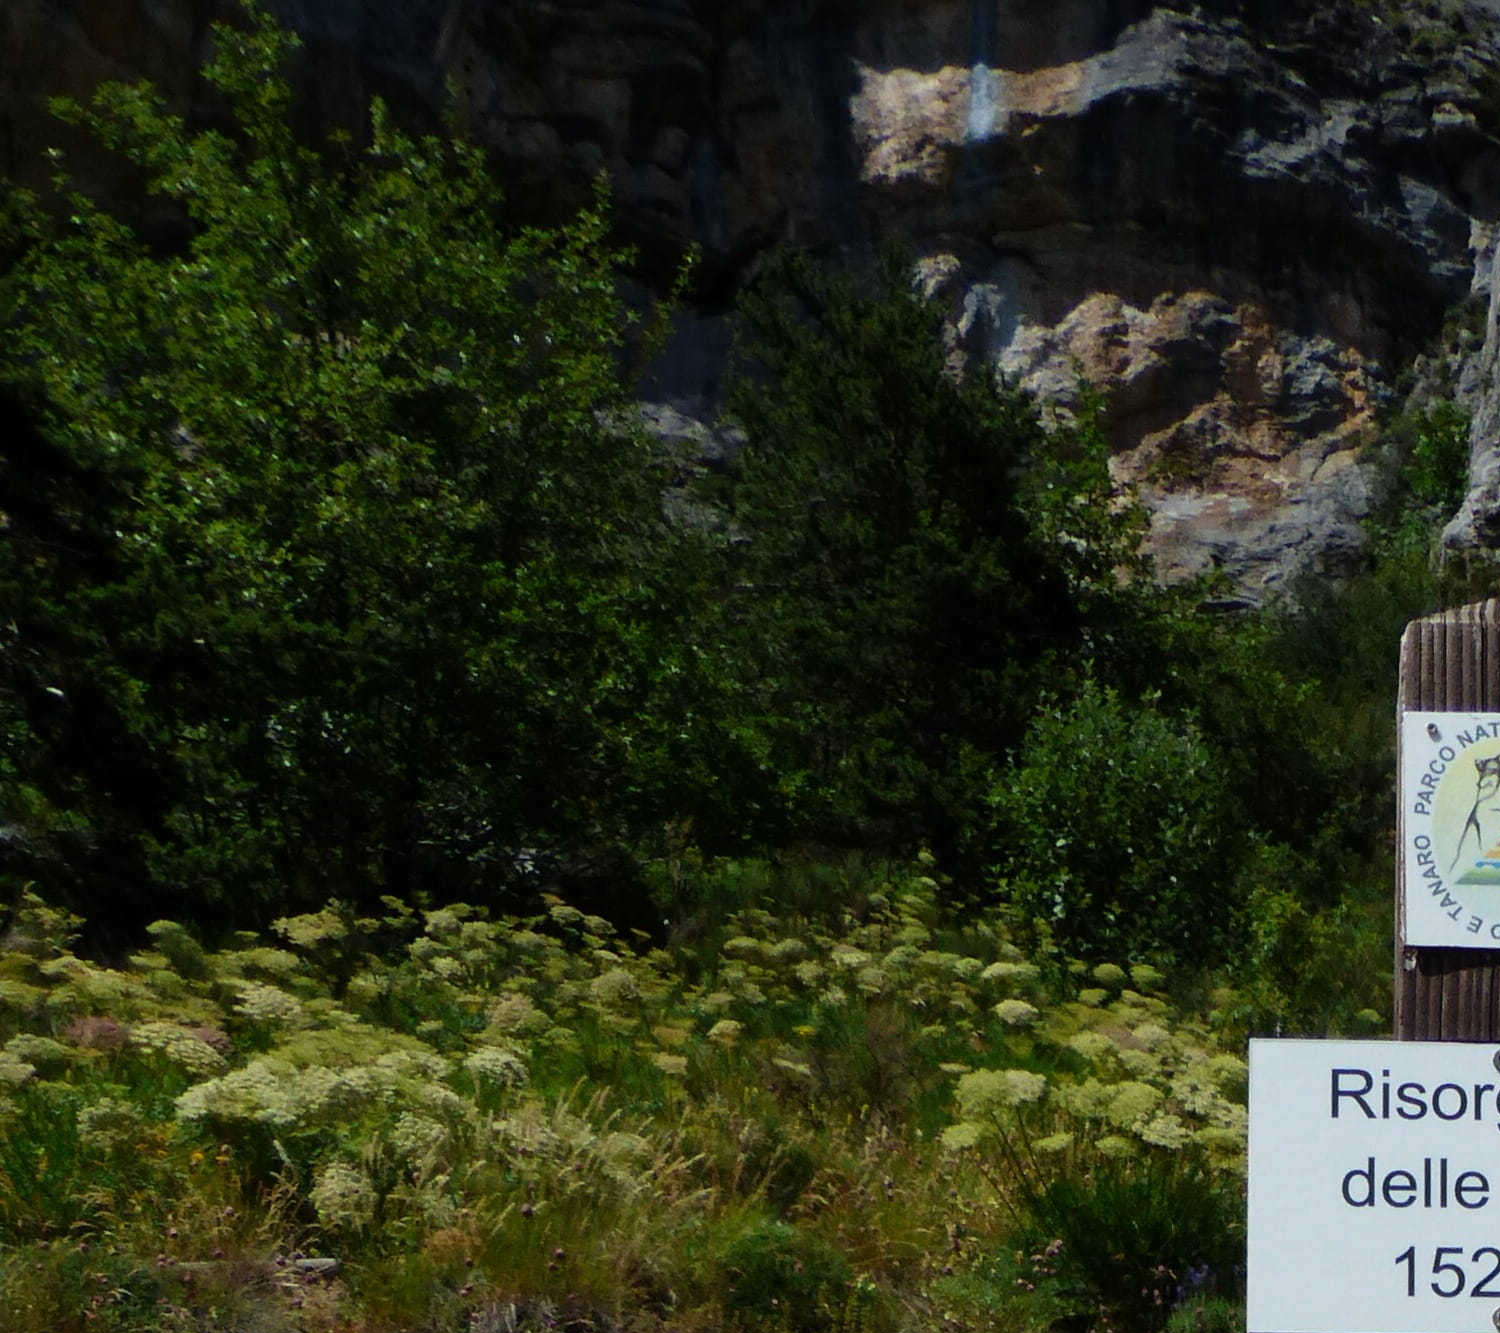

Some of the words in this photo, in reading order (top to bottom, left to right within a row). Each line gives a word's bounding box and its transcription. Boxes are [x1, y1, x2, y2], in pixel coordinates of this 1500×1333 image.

[1414, 746, 1455, 815] PARCO
[1414, 835, 1463, 921] TANARO
[1467, 916, 1483, 934] E
[1341, 1156, 1490, 1210] delle
